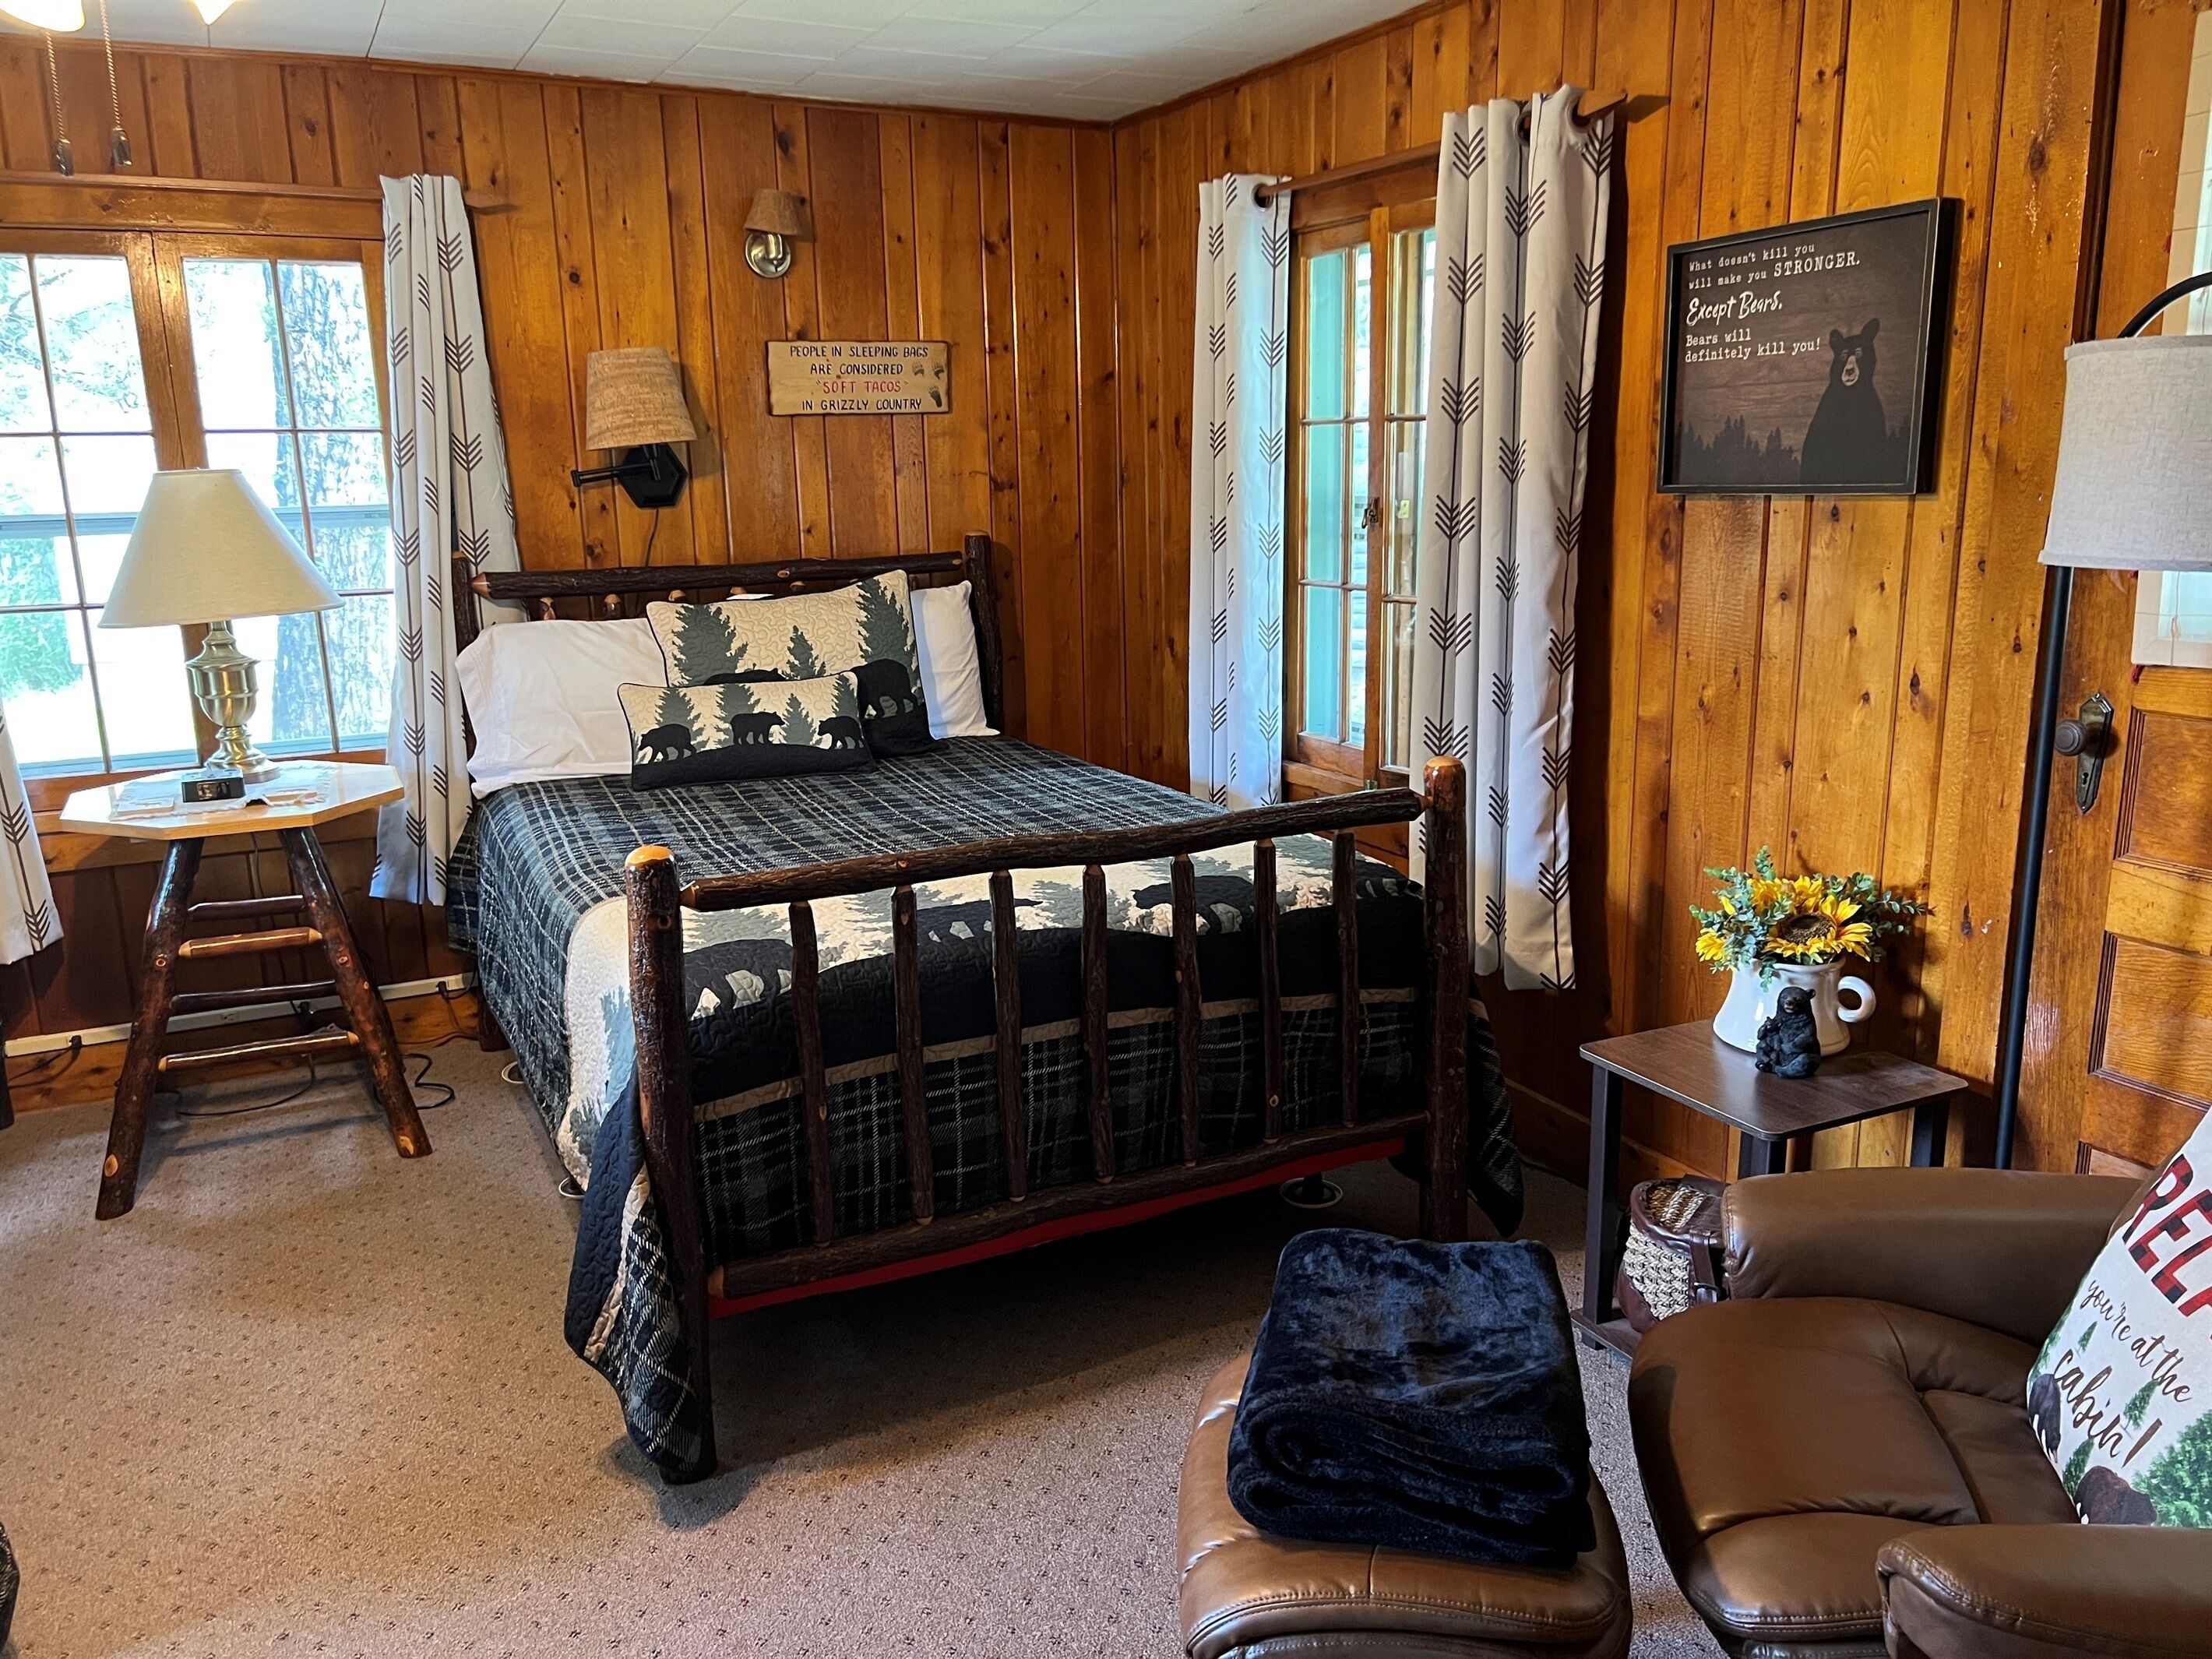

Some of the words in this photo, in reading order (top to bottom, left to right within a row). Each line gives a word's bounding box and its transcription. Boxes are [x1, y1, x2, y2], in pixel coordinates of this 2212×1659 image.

[1689, 261, 1712, 273] What
[1718, 252, 1756, 267] doesn't
[1763, 247, 1788, 261] kill
[1795, 245, 1815, 258] you
[1689, 277, 1712, 290] will
[1717, 273, 1742, 286] make
[1747, 270, 1766, 284] you
[1773, 251, 1860, 277] STRONGER.
[1686, 295, 1737, 326] Except
[1738, 291, 1783, 319] Bears.
[1685, 335, 1718, 347] Bears
[1724, 328, 1752, 343] will
[1685, 346, 1751, 362] definitely
[1757, 341, 1785, 356] kill
[1791, 337, 1820, 356] you!
[790, 346, 827, 358] PEOPLE
[831, 347, 842, 358] IN
[849, 346, 898, 358] SLEEPING
[903, 347, 928, 358] BAGS
[810, 364, 832, 375] ARE
[840, 364, 903, 375] CONSIDERED
[815, 379, 857, 393] "SOFT
[864, 380, 909, 393] TACOS"
[802, 400, 813, 410] IN
[821, 400, 868, 410] GRIZZLY
[876, 399, 922, 410] COUNTRY
[2080, 1280, 2132, 1341] you're
[2131, 1335, 2165, 1367] at
[2151, 1348, 2193, 1402] the
[2053, 1348, 2163, 1468] cabin!
